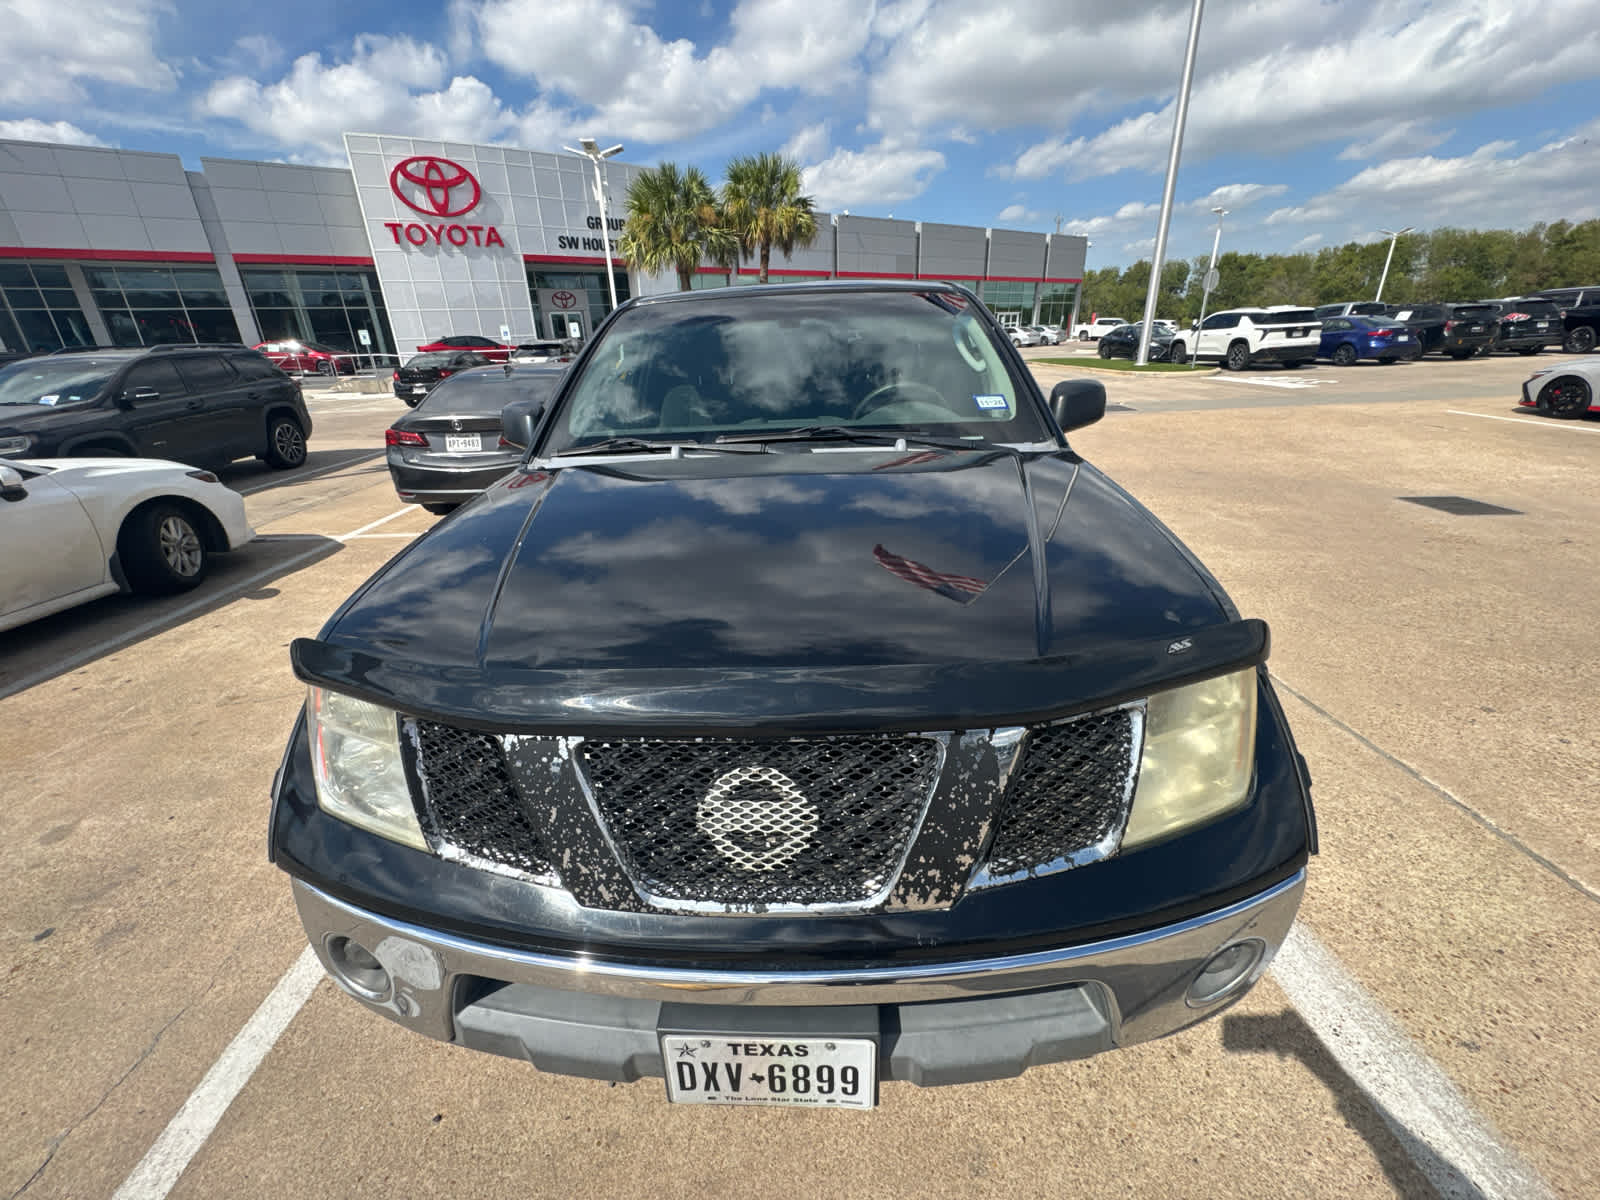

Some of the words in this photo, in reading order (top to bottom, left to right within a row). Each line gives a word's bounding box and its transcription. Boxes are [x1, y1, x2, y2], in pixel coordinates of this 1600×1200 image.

[384, 223, 505, 248] TOYOTA
[558, 235, 579, 250] SW
[728, 1043, 809, 1057] TEXAS
[676, 1061, 742, 1092] DXV
[768, 1064, 860, 1096] 6899
